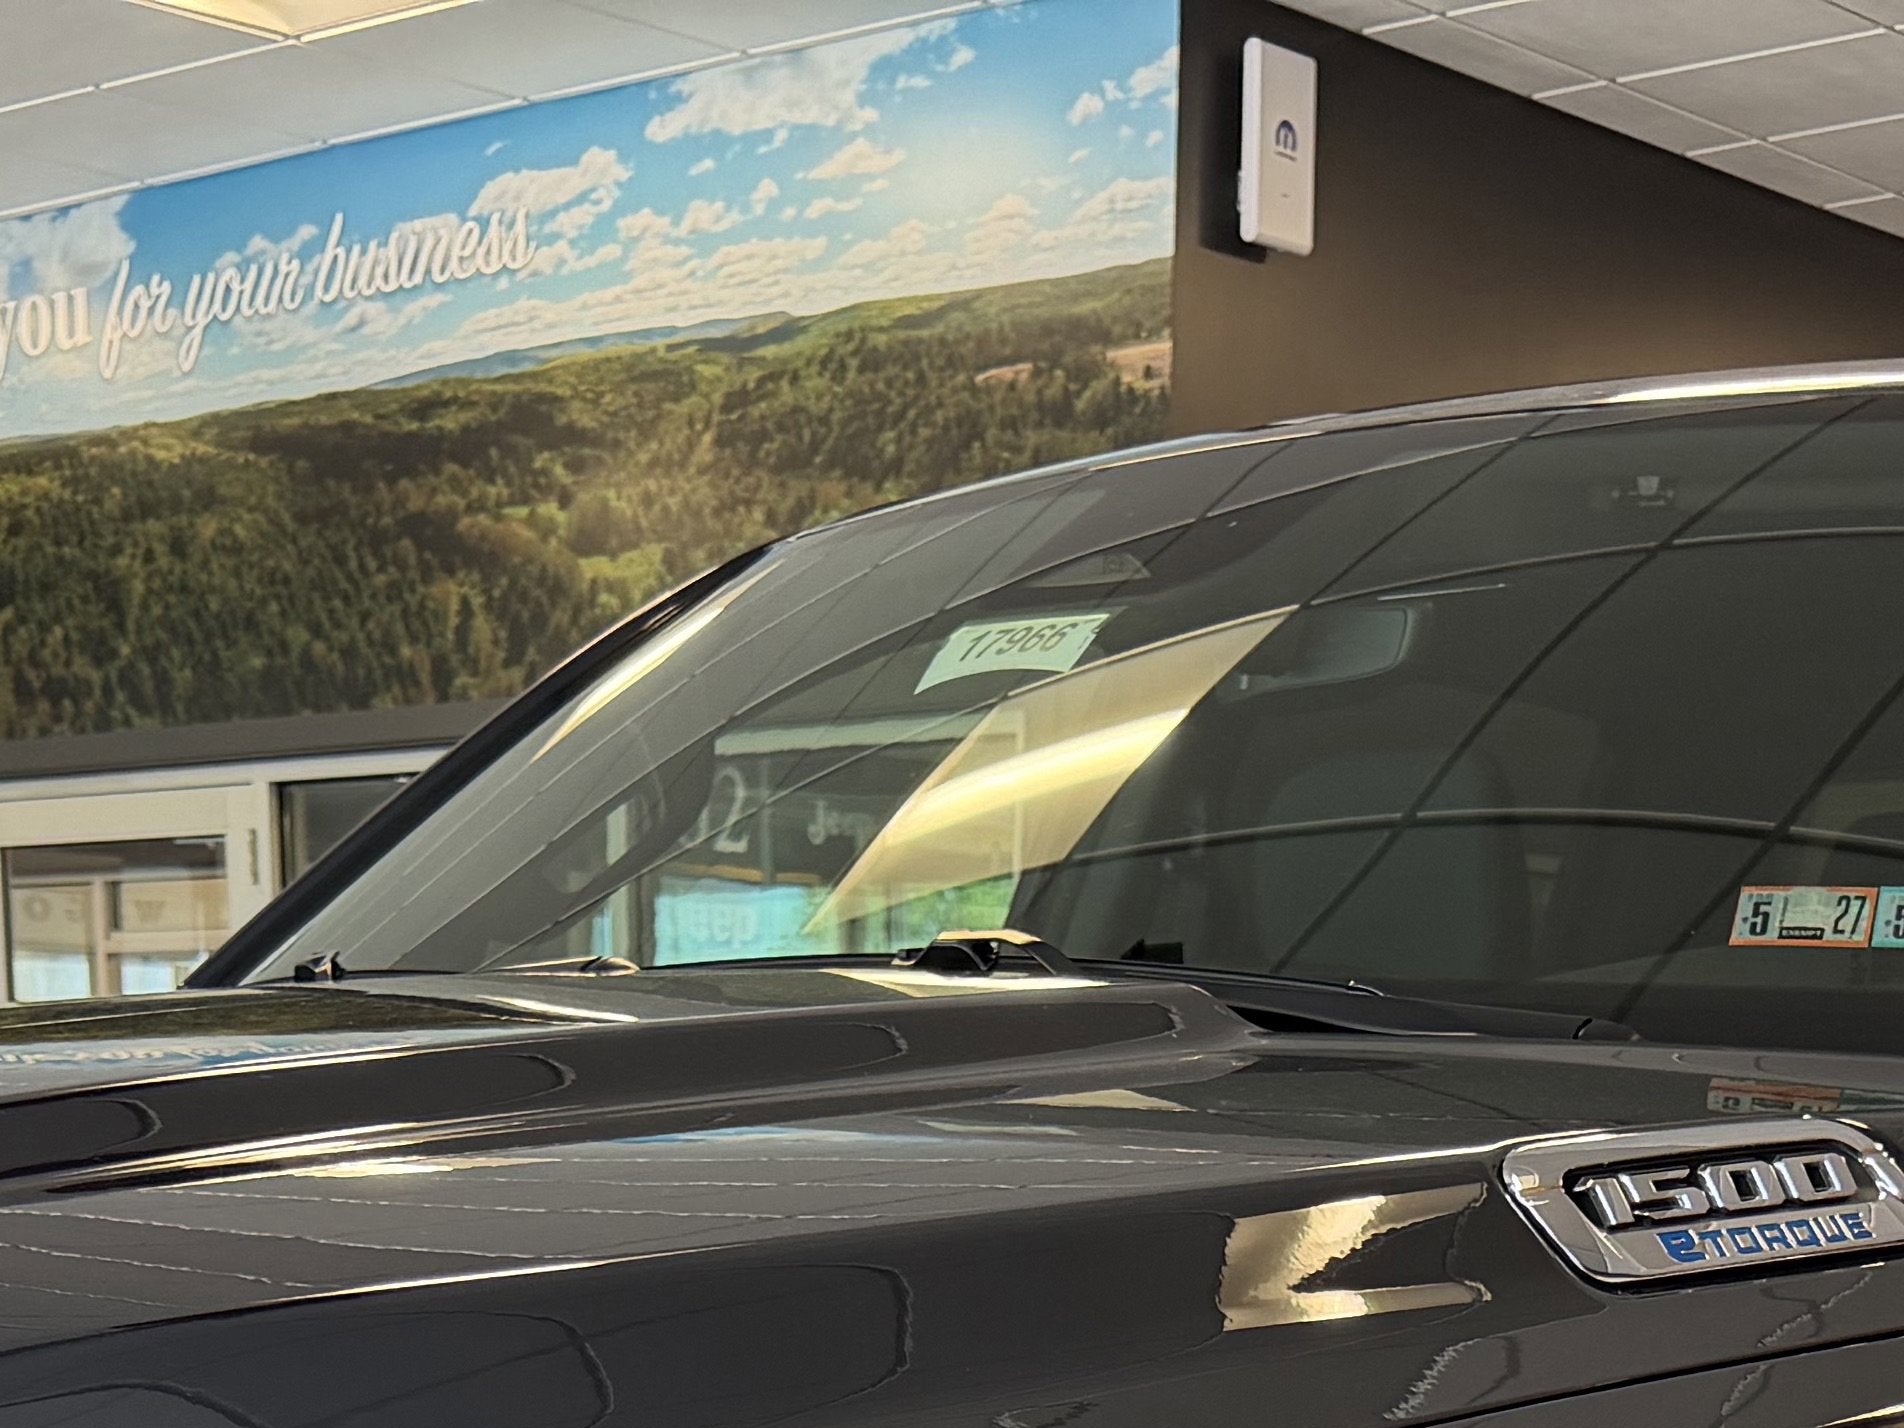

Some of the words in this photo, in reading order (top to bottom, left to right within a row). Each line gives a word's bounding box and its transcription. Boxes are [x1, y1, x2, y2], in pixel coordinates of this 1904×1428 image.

[100, 258, 180, 379] for
[182, 257, 308, 373] your
[313, 206, 539, 304] business
[958, 622, 1080, 662] 17966
[1749, 901, 1773, 937] 5
[1832, 895, 1868, 939] 27
[1574, 1152, 1862, 1229] 1500
